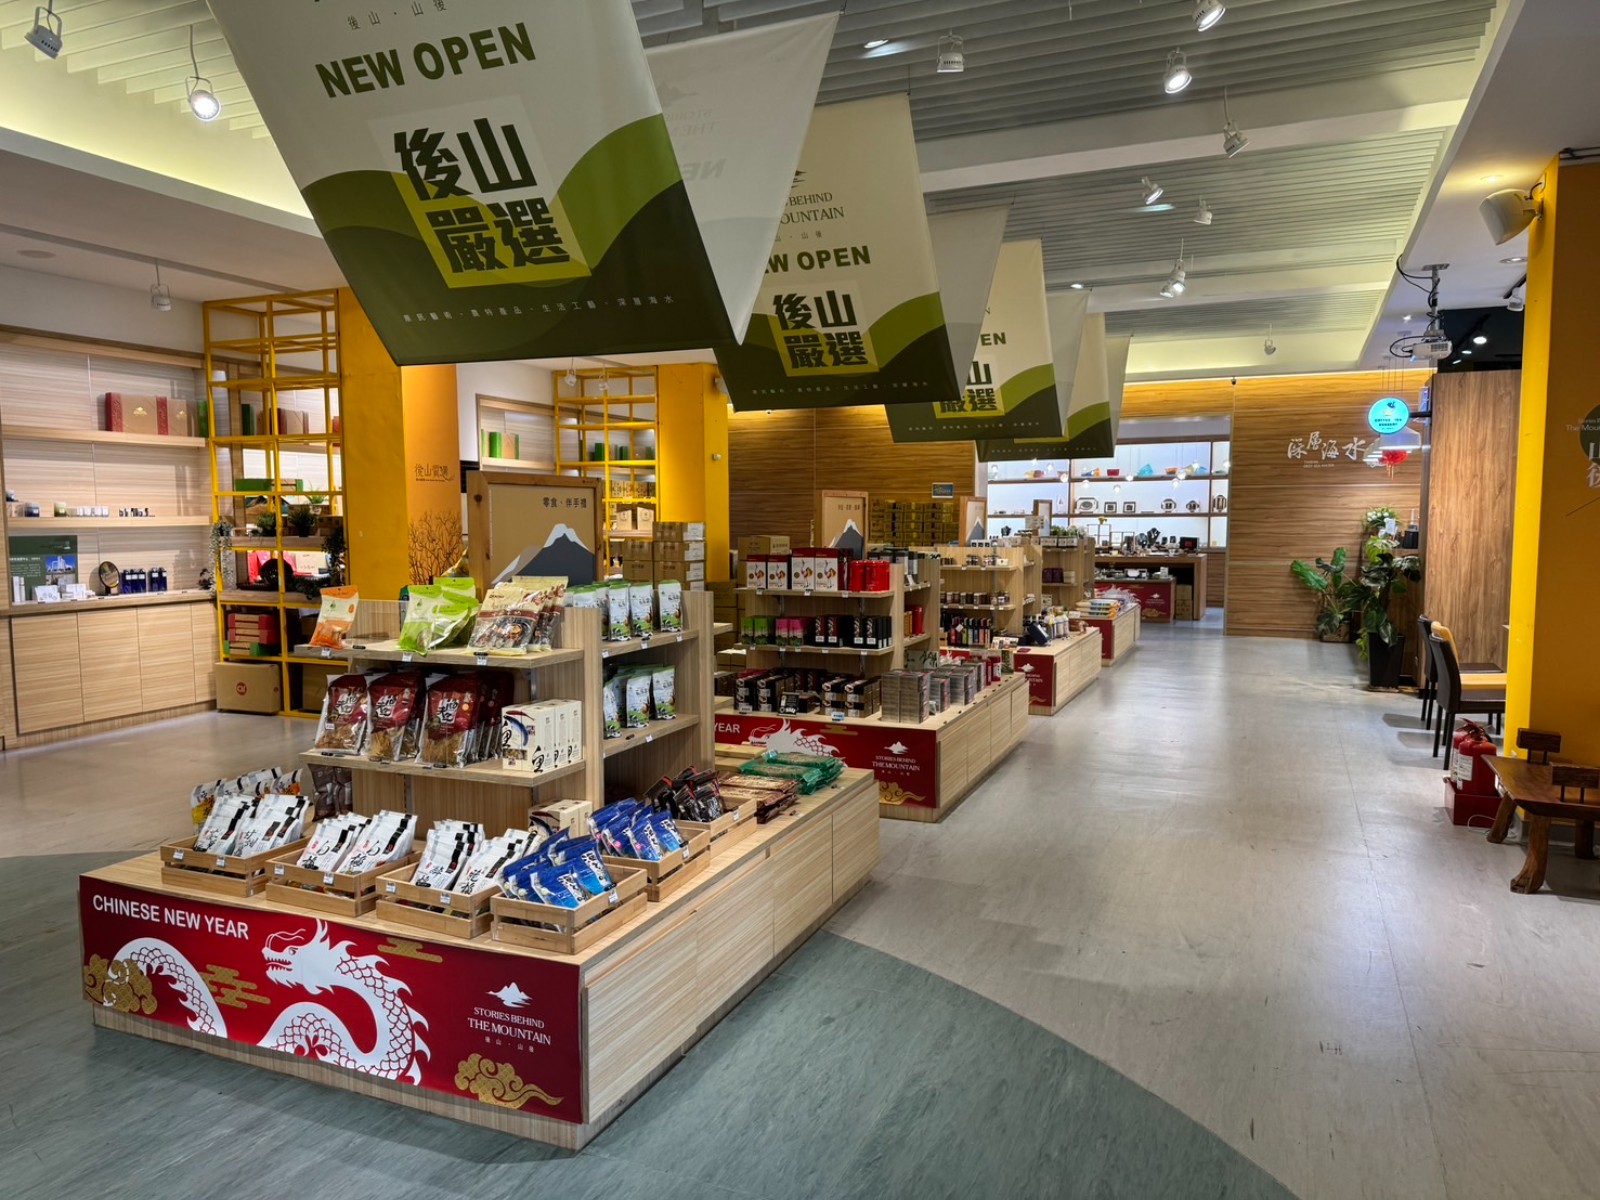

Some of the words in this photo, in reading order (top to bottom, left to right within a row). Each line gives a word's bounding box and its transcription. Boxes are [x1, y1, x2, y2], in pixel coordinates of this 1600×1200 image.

[315, 49, 405, 98] NEW
[413, 22, 536, 80] OPEN
[393, 117, 538, 202] 後山
[789, 192, 833, 206] BEHIND
[780, 206, 845, 225] OUNTAIN
[426, 197, 570, 274] 嚴選
[797, 245, 871, 271] OPEN
[772, 289, 857, 331] 後山
[784, 331, 869, 370] 嚴選
[980, 332, 1006, 346] EN
[966, 361, 992, 385] 山
[92, 894, 161, 922] CHINESE
[164, 908, 201, 931] NEW
[204, 915, 250, 941] YEAR
[467, 1016, 490, 1032] THE
[490, 1020, 551, 1046] MOUNTAIN
[473, 1006, 510, 1023] STORIES
[510, 1012, 545, 1030] BEHIND
